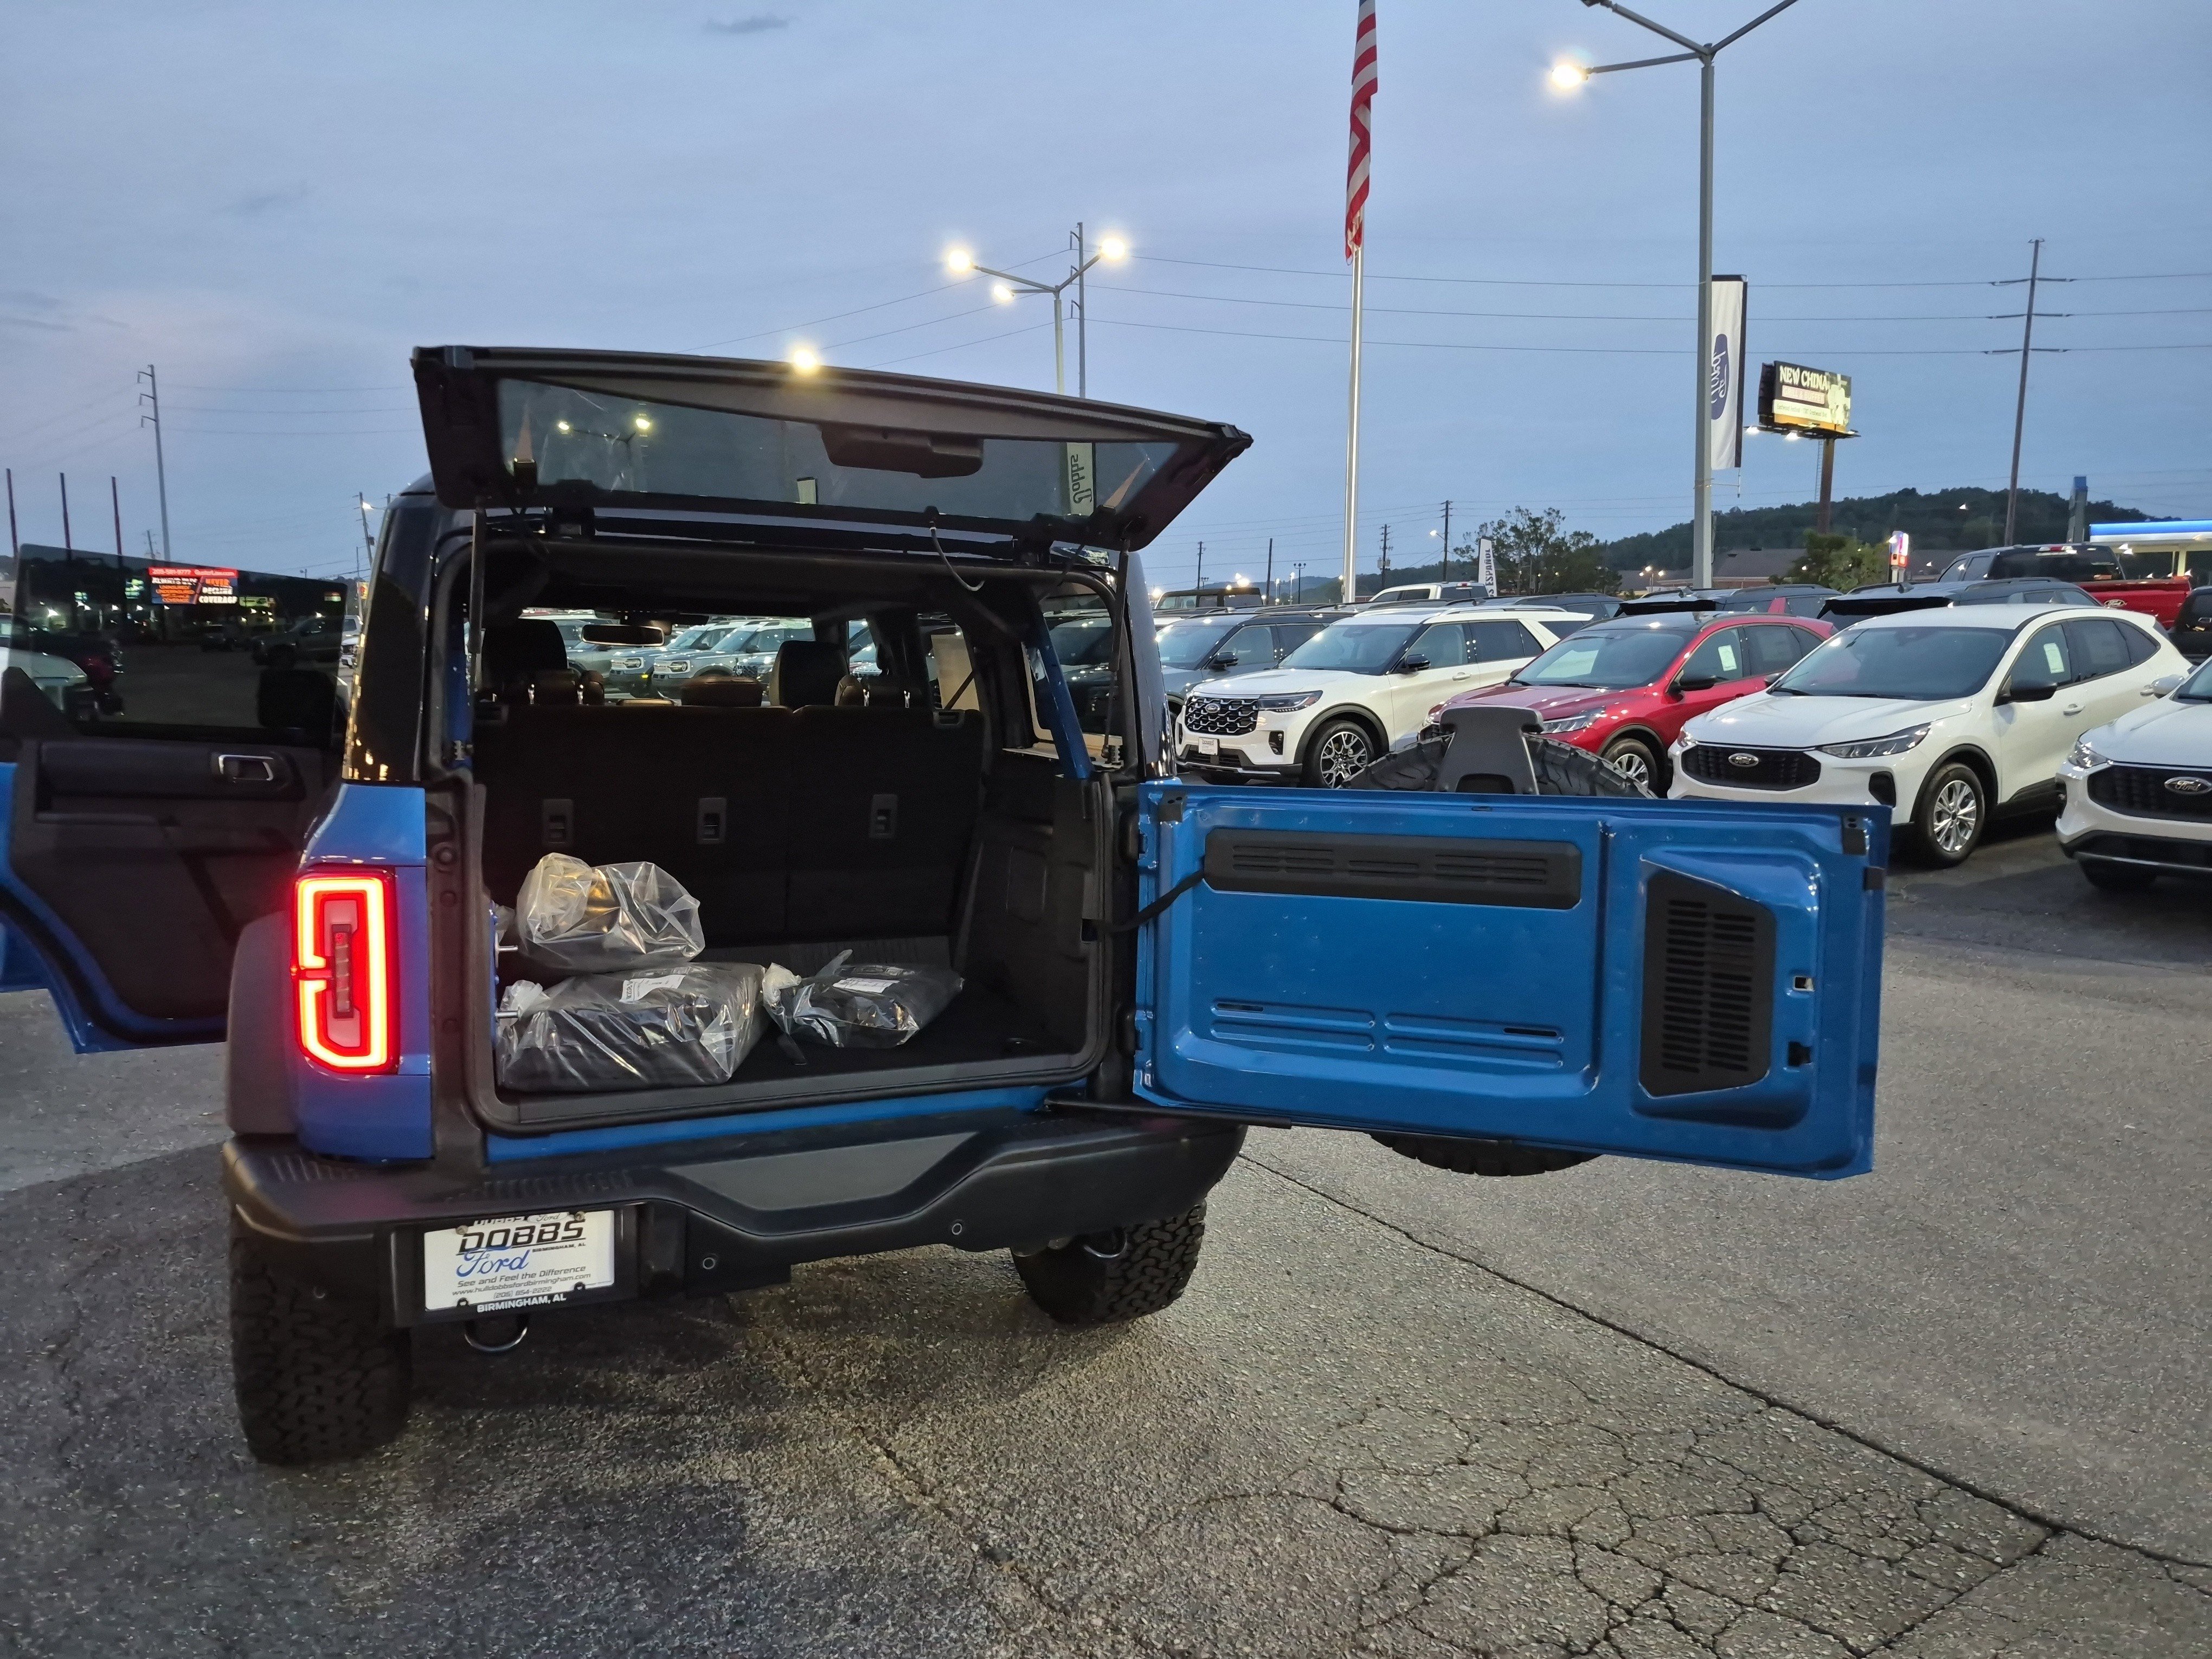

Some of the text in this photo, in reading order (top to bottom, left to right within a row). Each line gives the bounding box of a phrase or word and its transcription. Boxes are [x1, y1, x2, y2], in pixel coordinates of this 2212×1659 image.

[1779, 365, 1829, 391] NEW CHINA
[1484, 549, 1494, 586] ESPAÑOL
[202, 587, 233, 595] DECLINE
[537, 1213, 561, 1221] Ford
[459, 1219, 585, 1253] DOBBS
[532, 1244, 576, 1252] BIRMINGHAM,
[456, 1245, 530, 1277] Ford
[452, 1273, 591, 1296] www.hulldobbsfordbirmingham.com
[478, 1276, 497, 1285] and
[499, 1273, 519, 1282] Feel
[539, 1266, 586, 1277] Difference
[477, 1293, 567, 1313] BIRMINGHAM, AL
